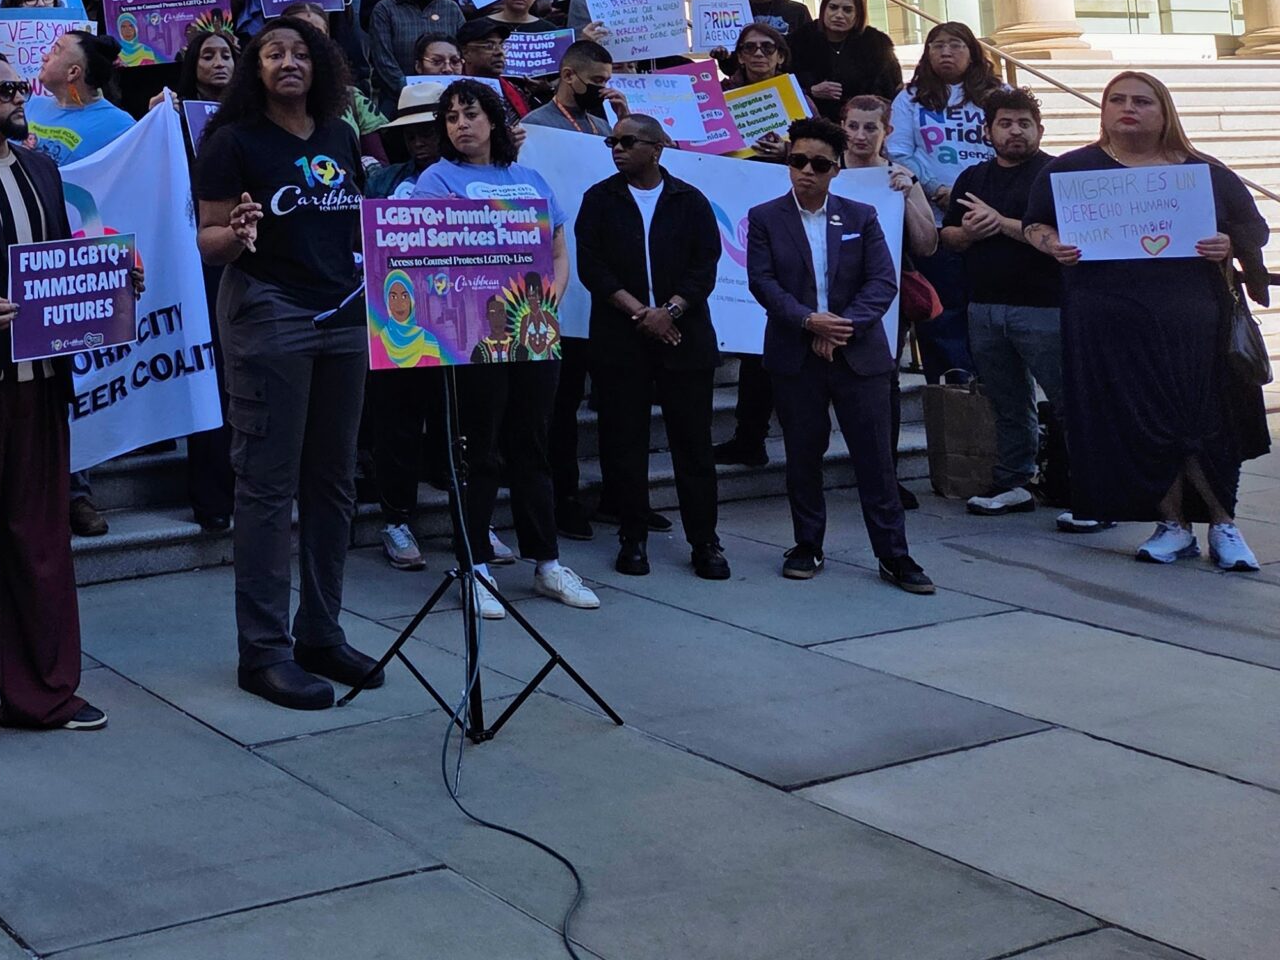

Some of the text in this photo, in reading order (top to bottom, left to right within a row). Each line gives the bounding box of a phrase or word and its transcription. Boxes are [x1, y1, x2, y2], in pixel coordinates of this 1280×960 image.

[703, 10, 742, 29] PRIDE
[526, 33, 556, 42] FLAGS
[529, 42, 555, 50] FUND
[527, 57, 556, 67] DOES.
[732, 96, 762, 110] migrante
[746, 120, 787, 138] oportunidad
[747, 112, 779, 127] buscando
[1057, 171, 1197, 202] MIGRAR ES UN
[270, 185, 363, 216] Caribbea
[1063, 197, 1180, 224] DERECHO HUMANO,
[376, 204, 538, 229] LGBTQ+ Immigrant
[1120, 219, 1173, 239] TAMBIEN
[376, 226, 541, 253] Legal Services Fund
[20, 243, 129, 273] FUND LGBTQ+
[389, 253, 533, 267] Access to Counsel Protects LGBTQ+ Lives
[23, 268, 128, 301] IMMIGRANT
[454, 274, 500, 292] Caribbean
[43, 298, 114, 327] FUTURES
[136, 302, 183, 346] CITY
